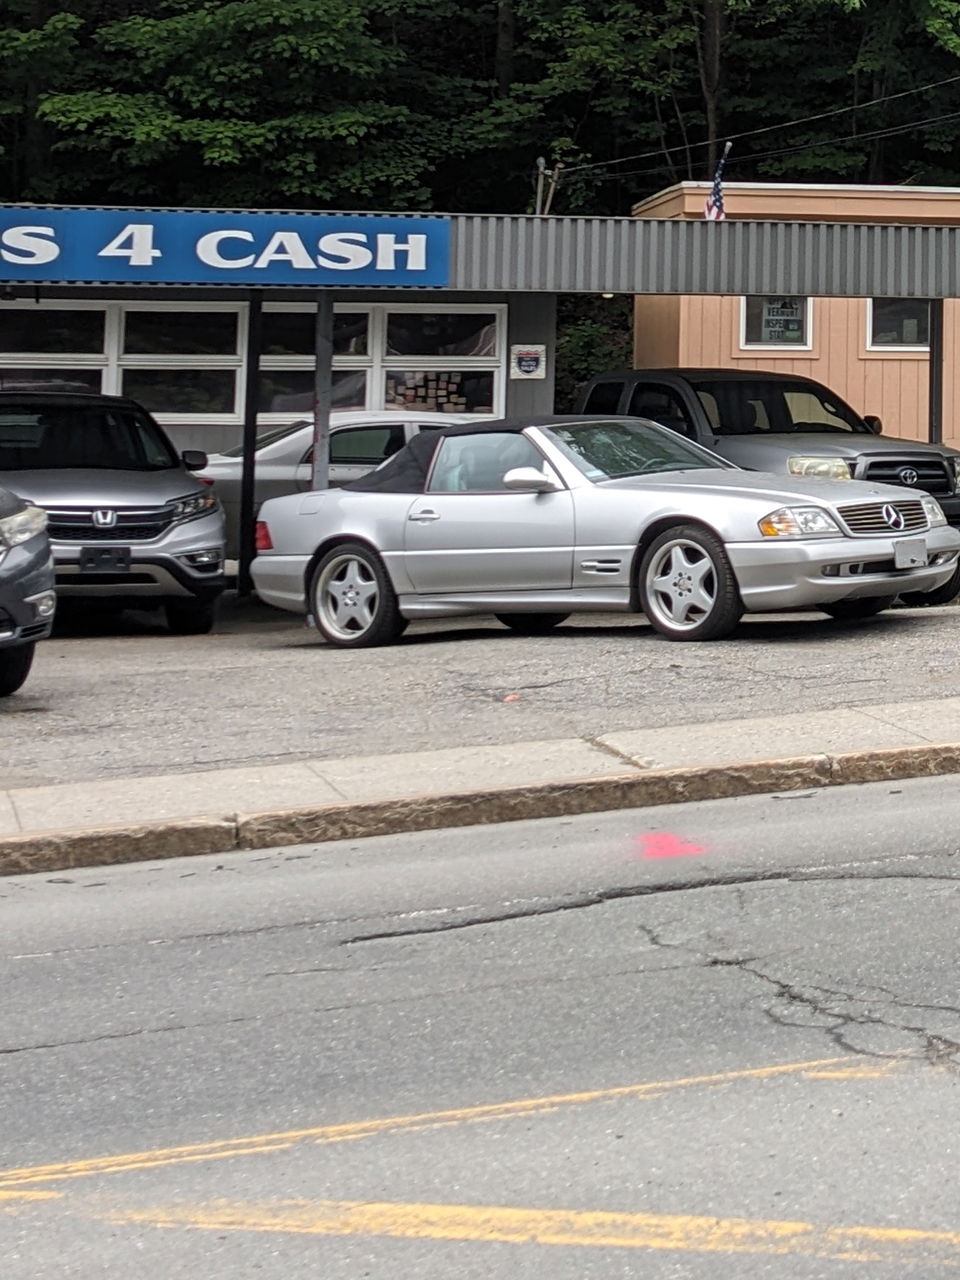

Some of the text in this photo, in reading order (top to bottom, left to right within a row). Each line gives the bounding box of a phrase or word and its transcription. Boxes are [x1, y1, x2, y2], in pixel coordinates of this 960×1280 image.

[1, 224, 427, 271] S 4 CASH
